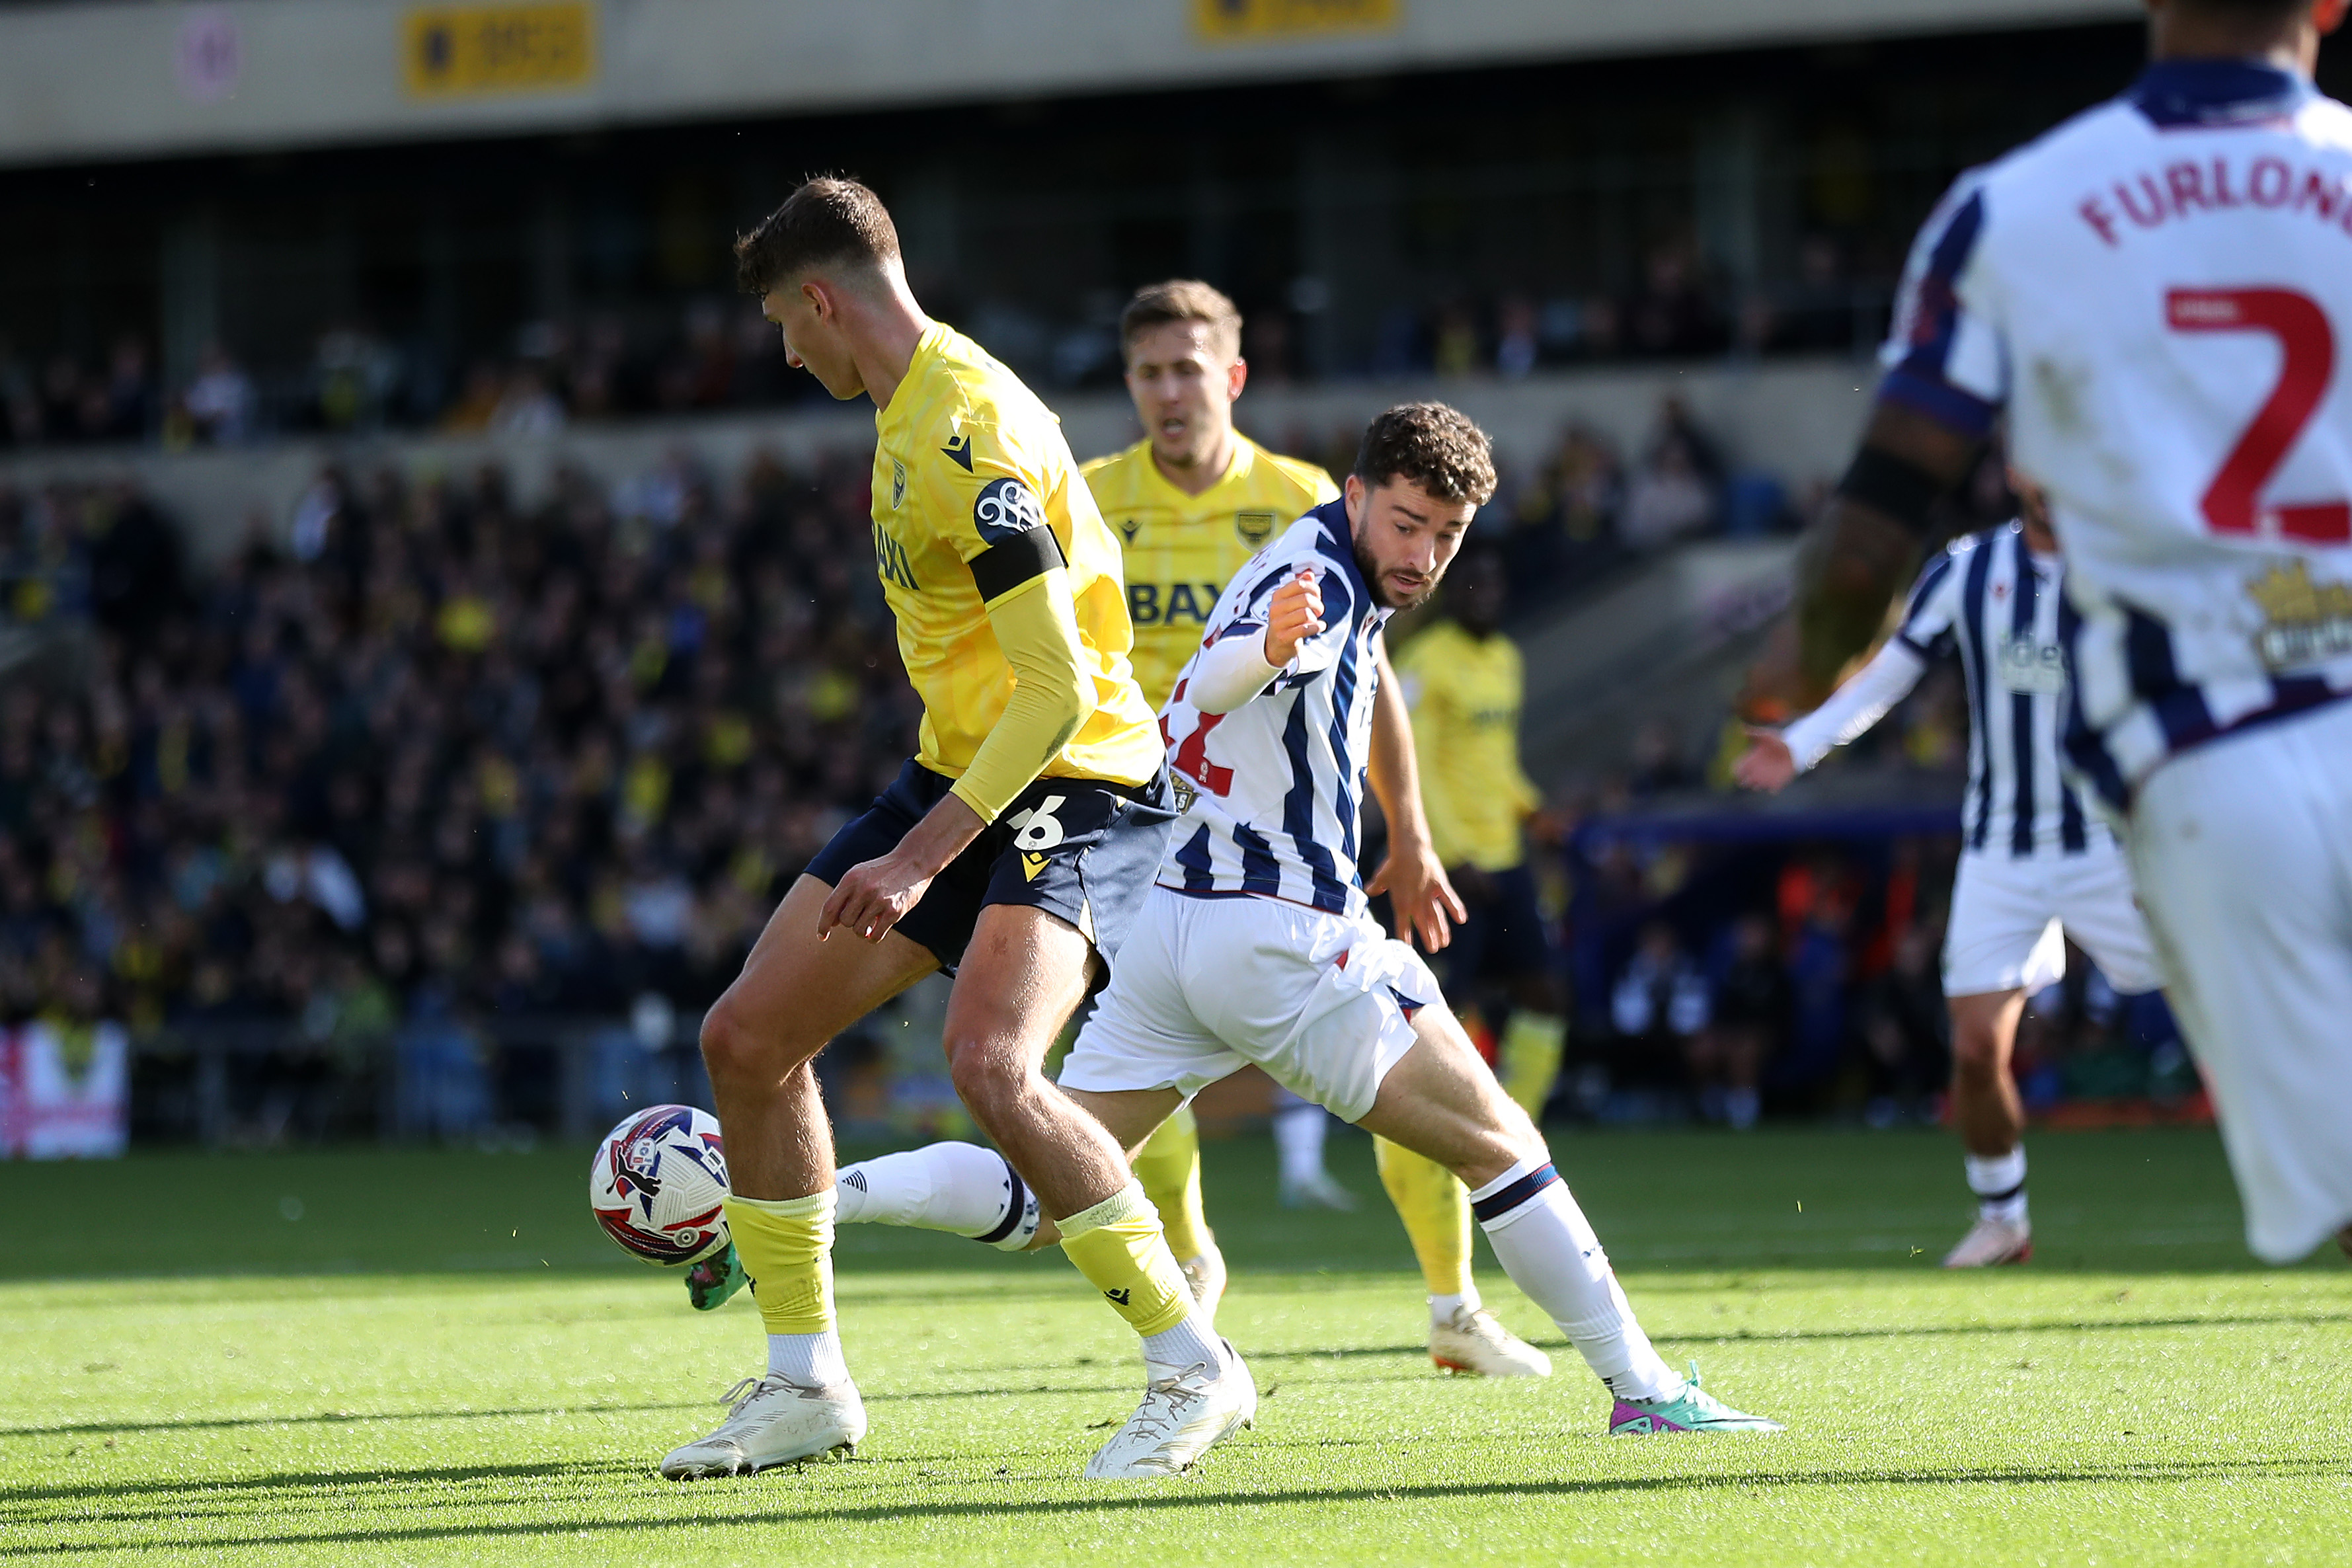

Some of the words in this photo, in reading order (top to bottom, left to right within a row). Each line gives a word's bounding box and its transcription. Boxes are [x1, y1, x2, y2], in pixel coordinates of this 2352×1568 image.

[2163, 286, 2351, 549] 2
[871, 517, 921, 591] AXI
[1128, 584, 1224, 624] BAX
